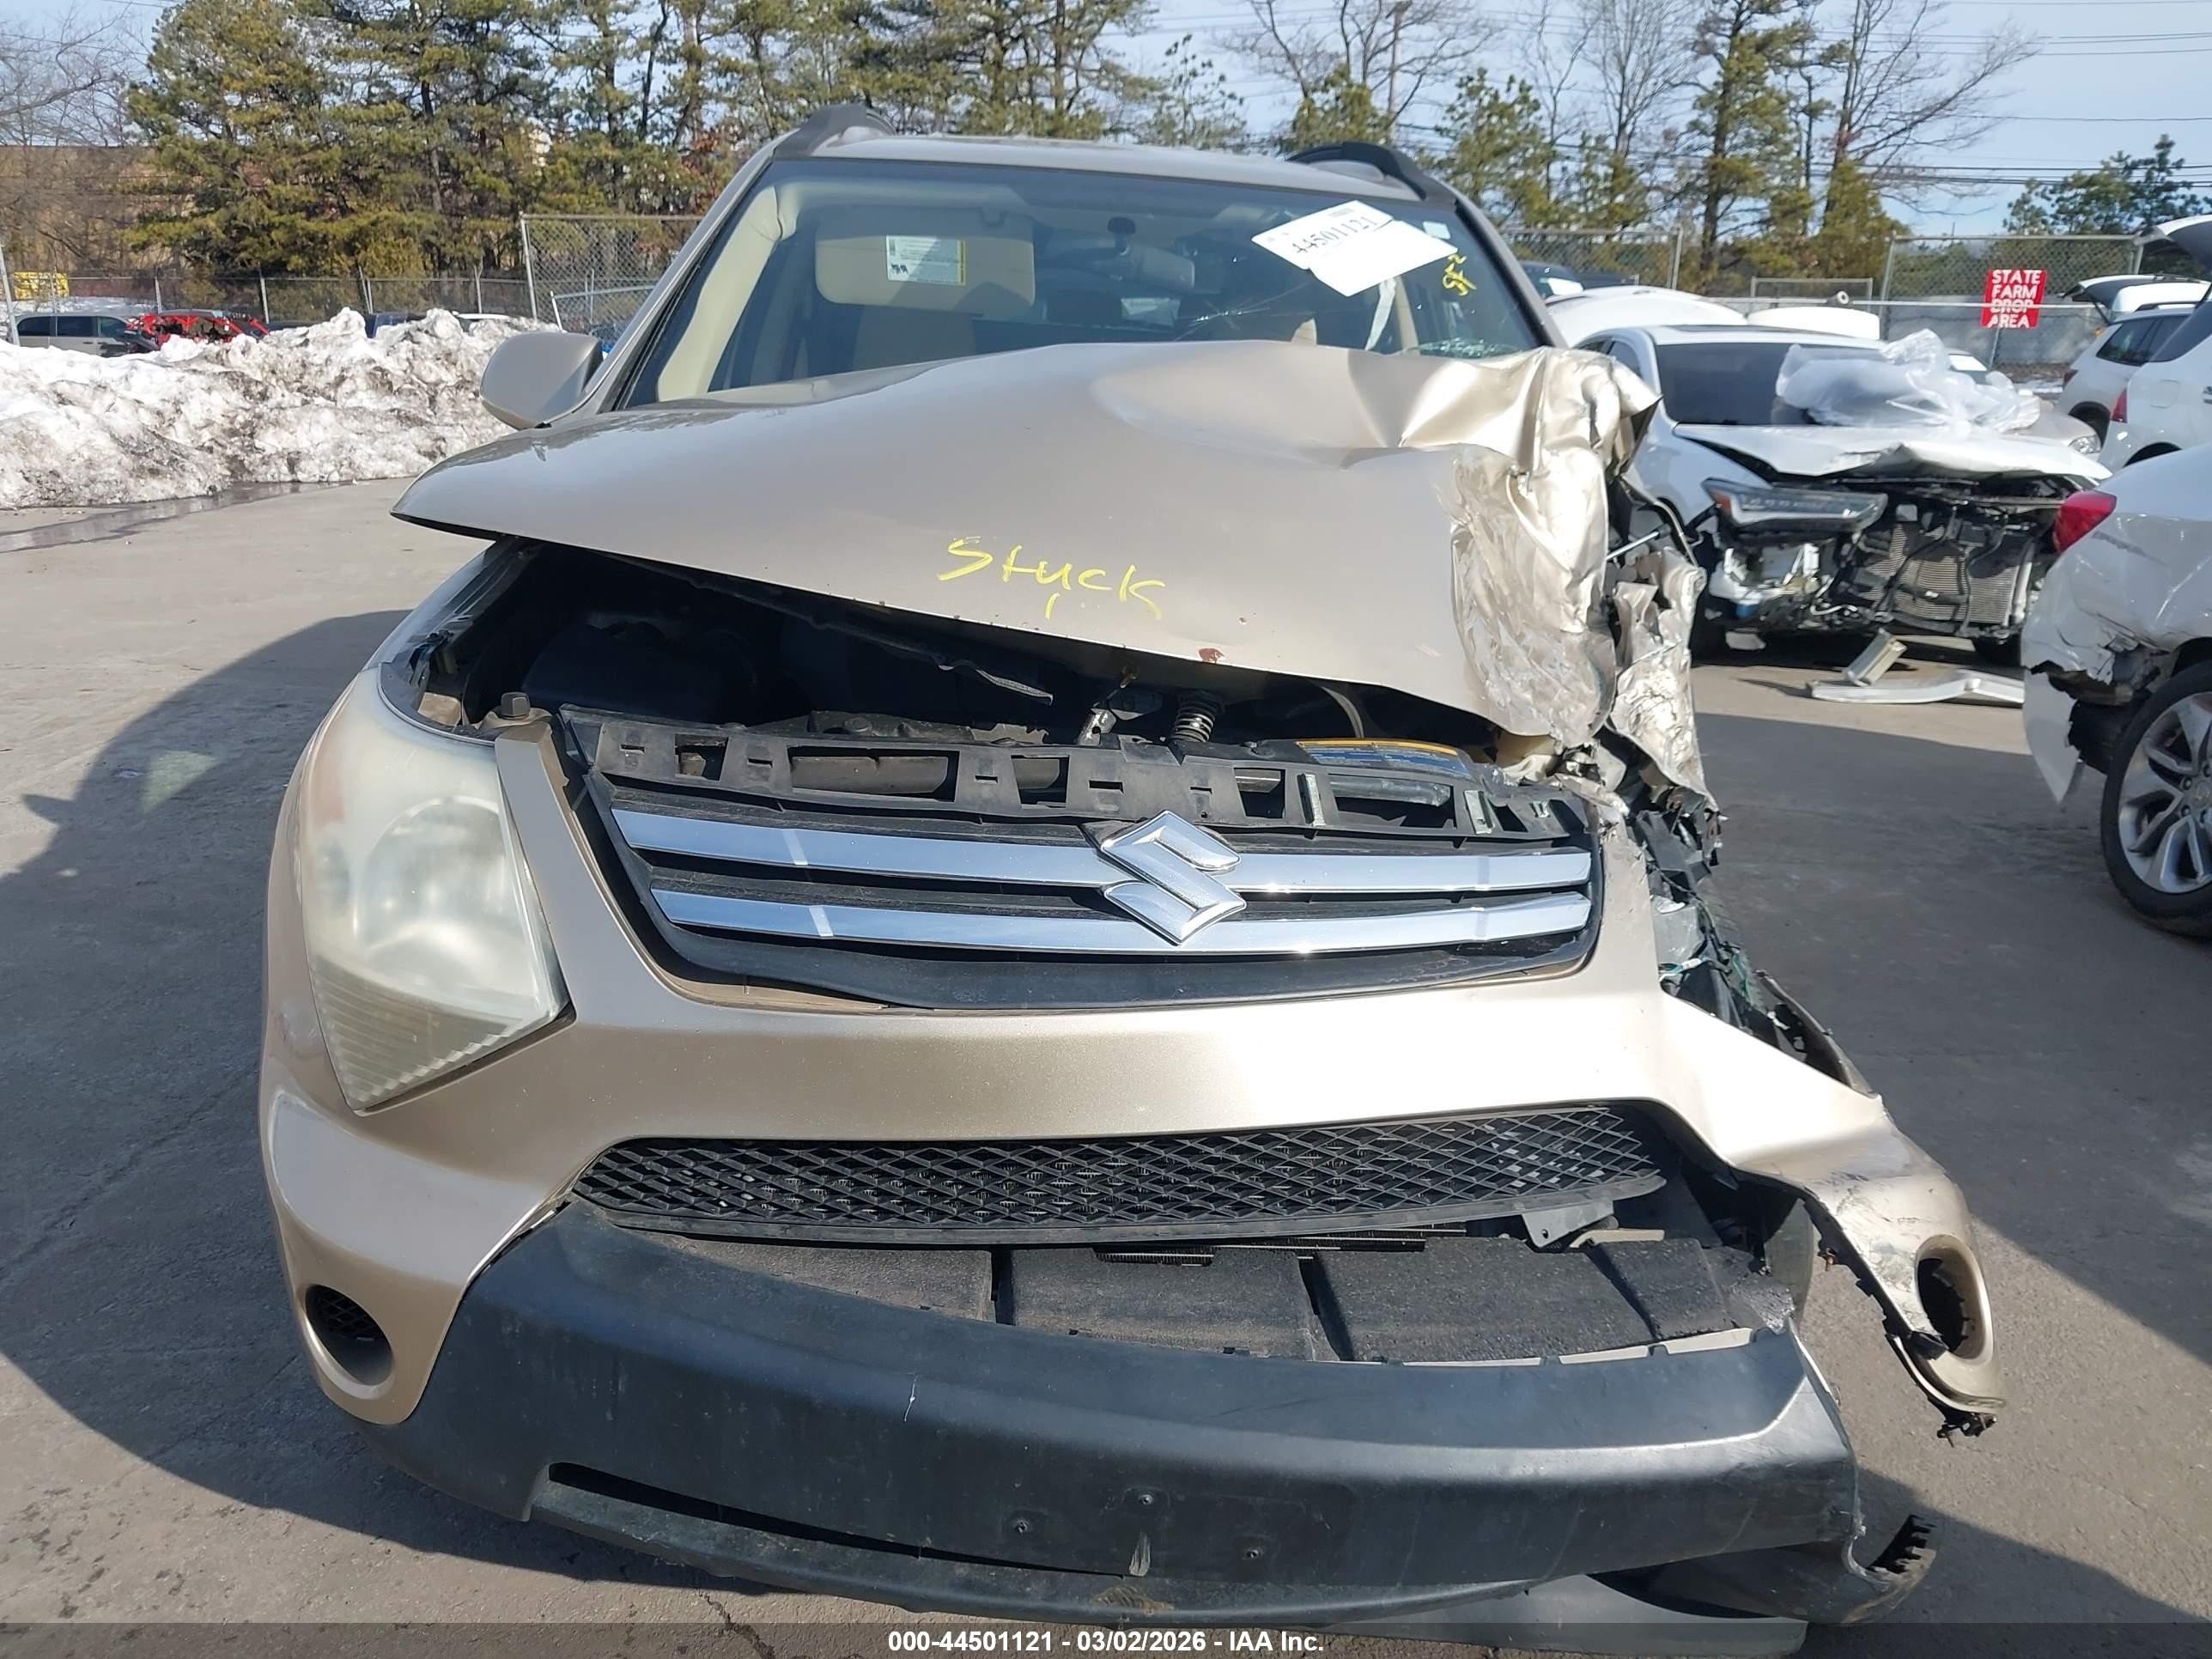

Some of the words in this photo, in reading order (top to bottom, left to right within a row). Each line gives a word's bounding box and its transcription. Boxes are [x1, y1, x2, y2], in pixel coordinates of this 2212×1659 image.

[1292, 216, 1378, 253] 44501121
[1991, 269, 2042, 284] STATE
[1991, 284, 2038, 299] FARM
[1989, 298, 2034, 313] DROP
[1986, 313, 2030, 328] AREA
